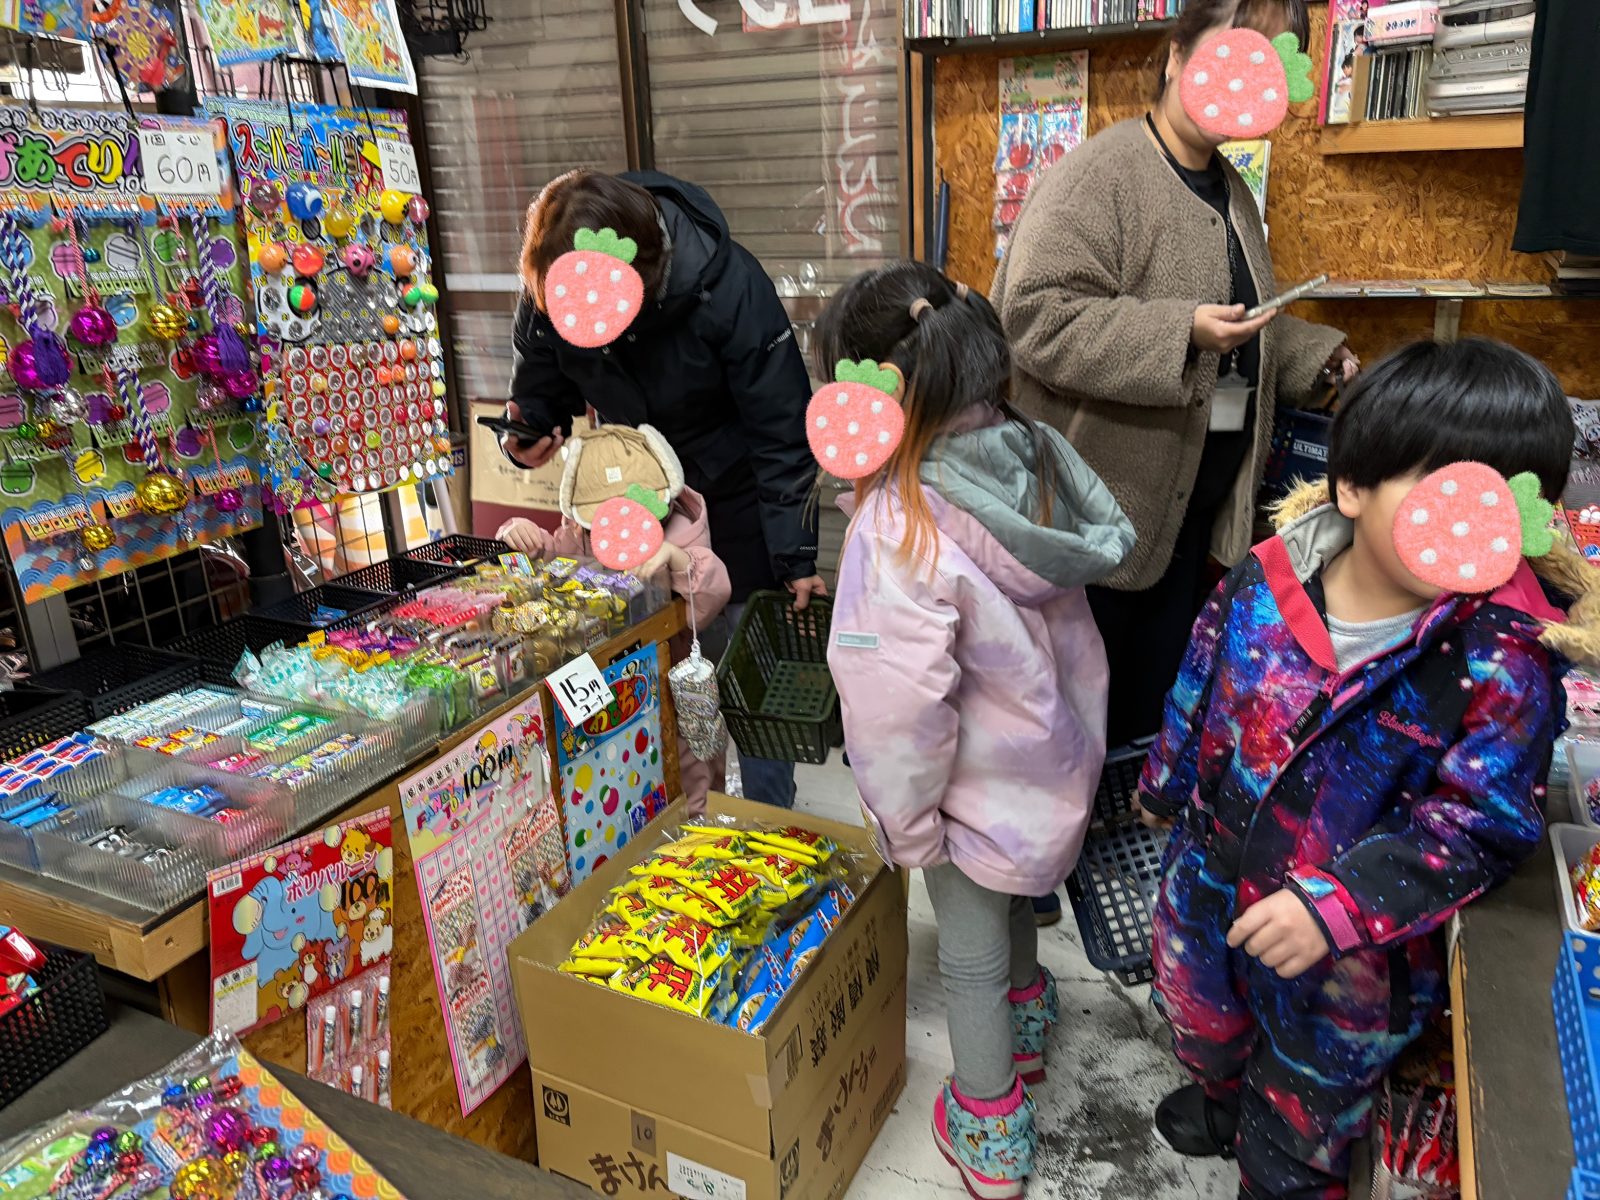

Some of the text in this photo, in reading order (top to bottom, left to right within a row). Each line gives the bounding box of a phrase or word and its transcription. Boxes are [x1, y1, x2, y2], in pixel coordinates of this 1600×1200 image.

[144, 133, 201, 146] 1回 くじ
[157, 153, 211, 184] 60円
[389, 159, 419, 185] 50円
[558, 672, 601, 708] 15円
[285, 849, 380, 904] ポリバルーン
[635, 1123, 654, 1141] 10
